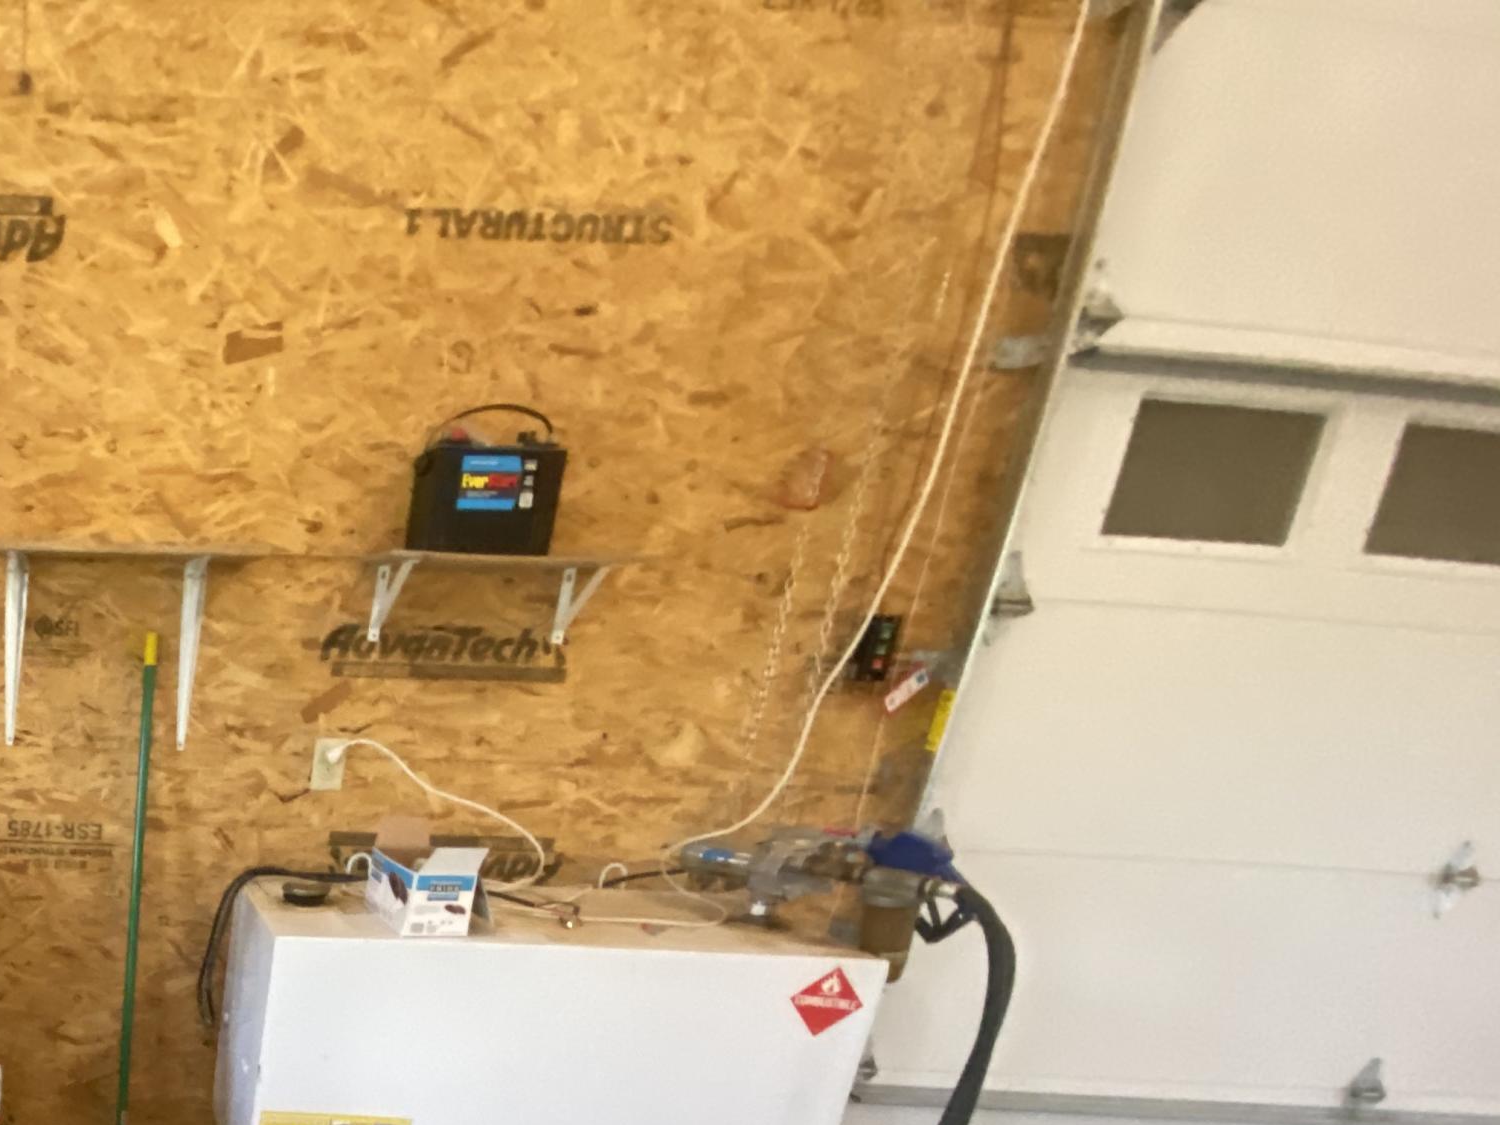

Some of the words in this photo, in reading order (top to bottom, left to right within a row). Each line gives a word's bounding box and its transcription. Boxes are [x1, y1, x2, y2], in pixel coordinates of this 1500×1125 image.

[433, 209, 674, 245] STRUCTURAL
[321, 624, 540, 663] AdvanTech
[7, 820, 103, 841] ESR-1785
